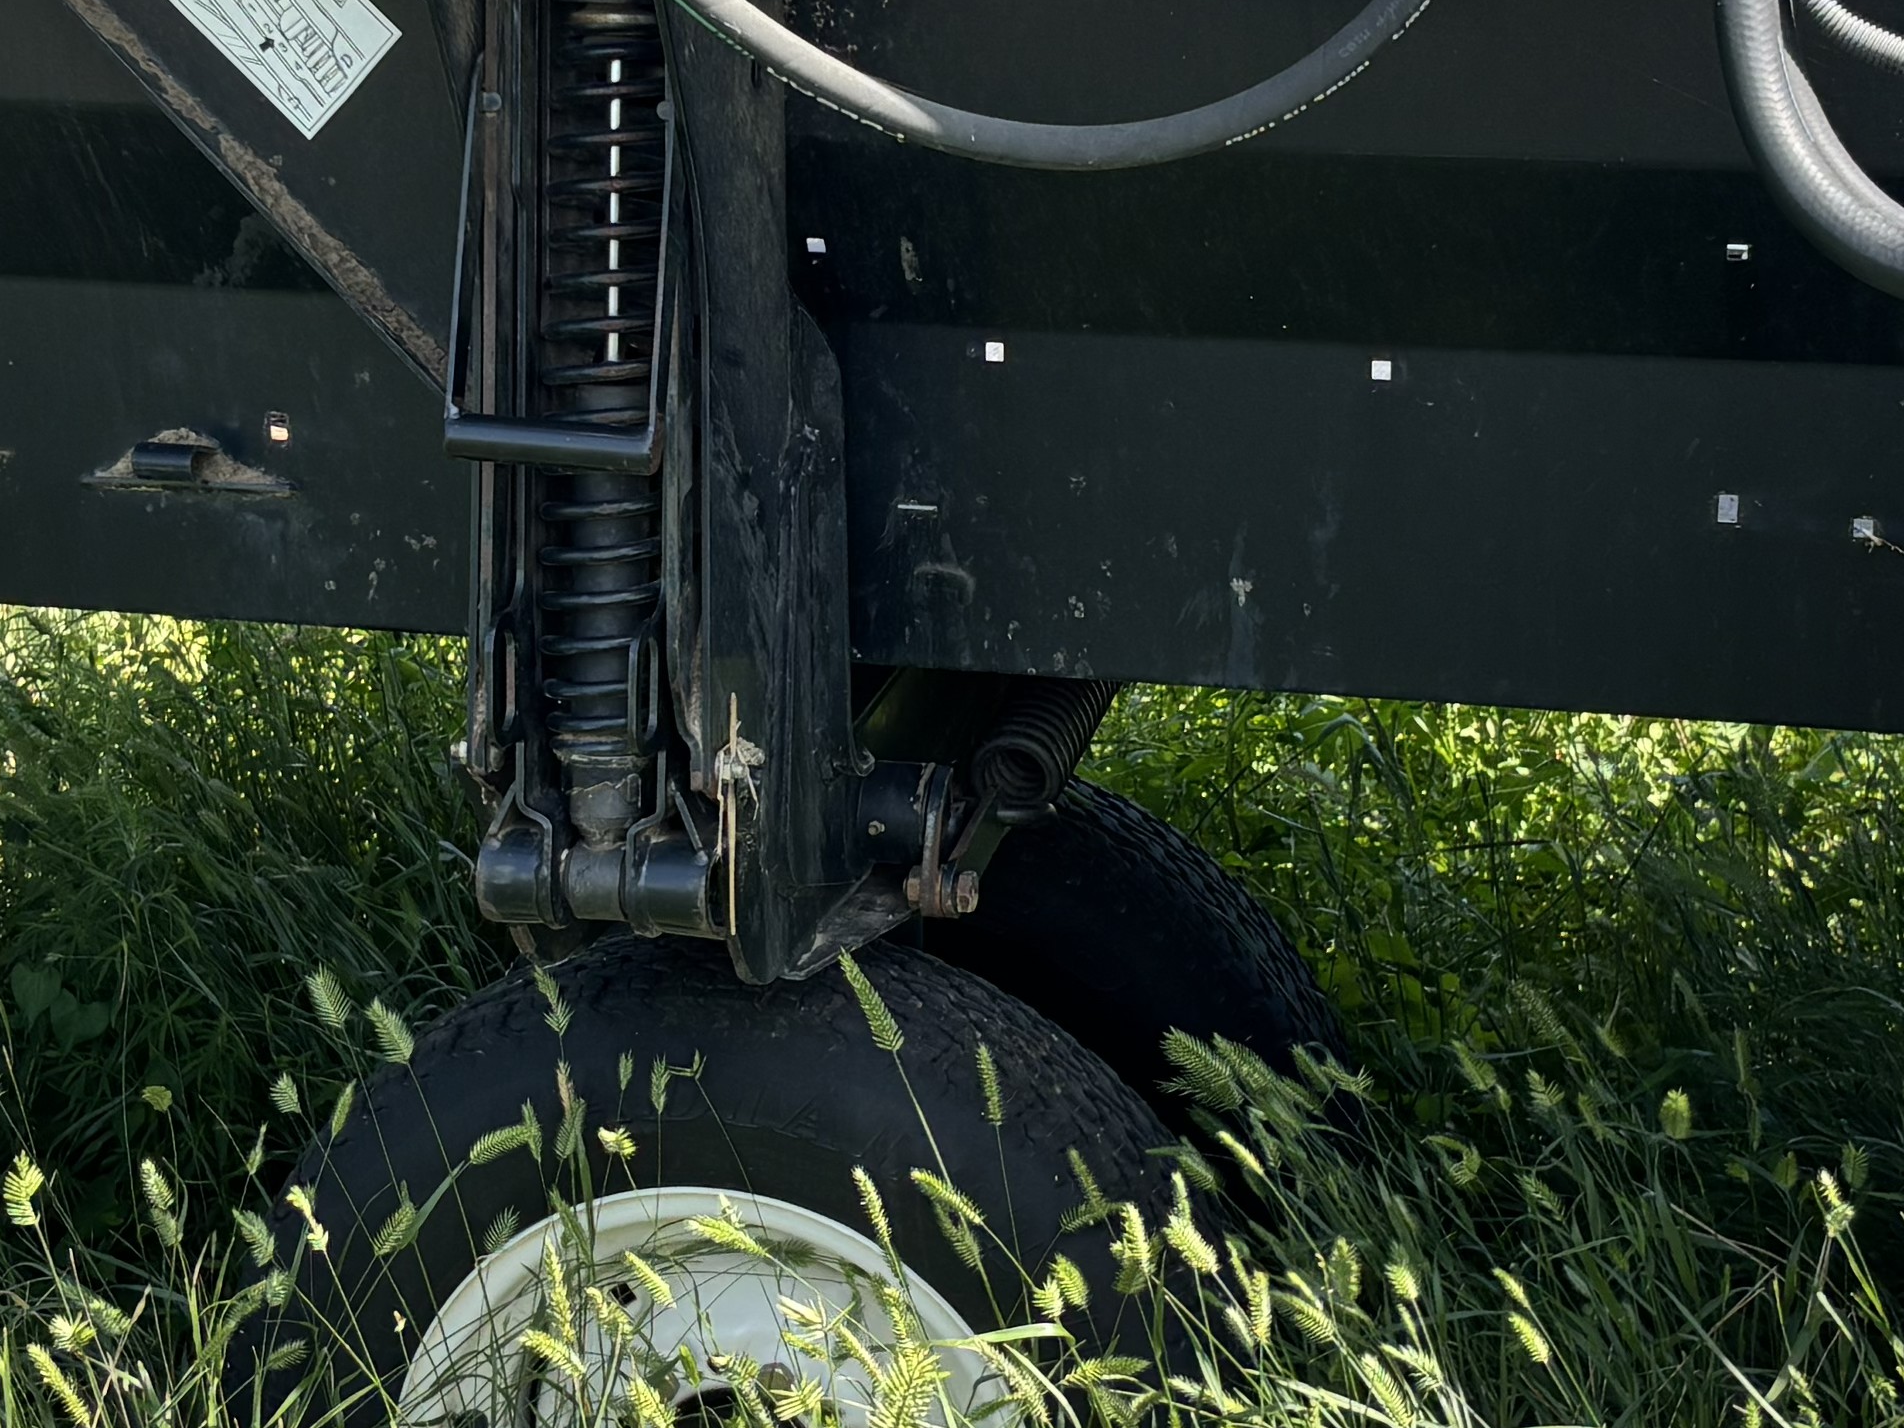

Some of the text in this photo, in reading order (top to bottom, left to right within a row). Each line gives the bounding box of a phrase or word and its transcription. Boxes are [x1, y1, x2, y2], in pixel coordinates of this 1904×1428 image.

[263, 23, 273, 34] 2
[278, 43, 288, 53] 3
[294, 60, 304, 71] 4
[340, 54, 353, 69] D
